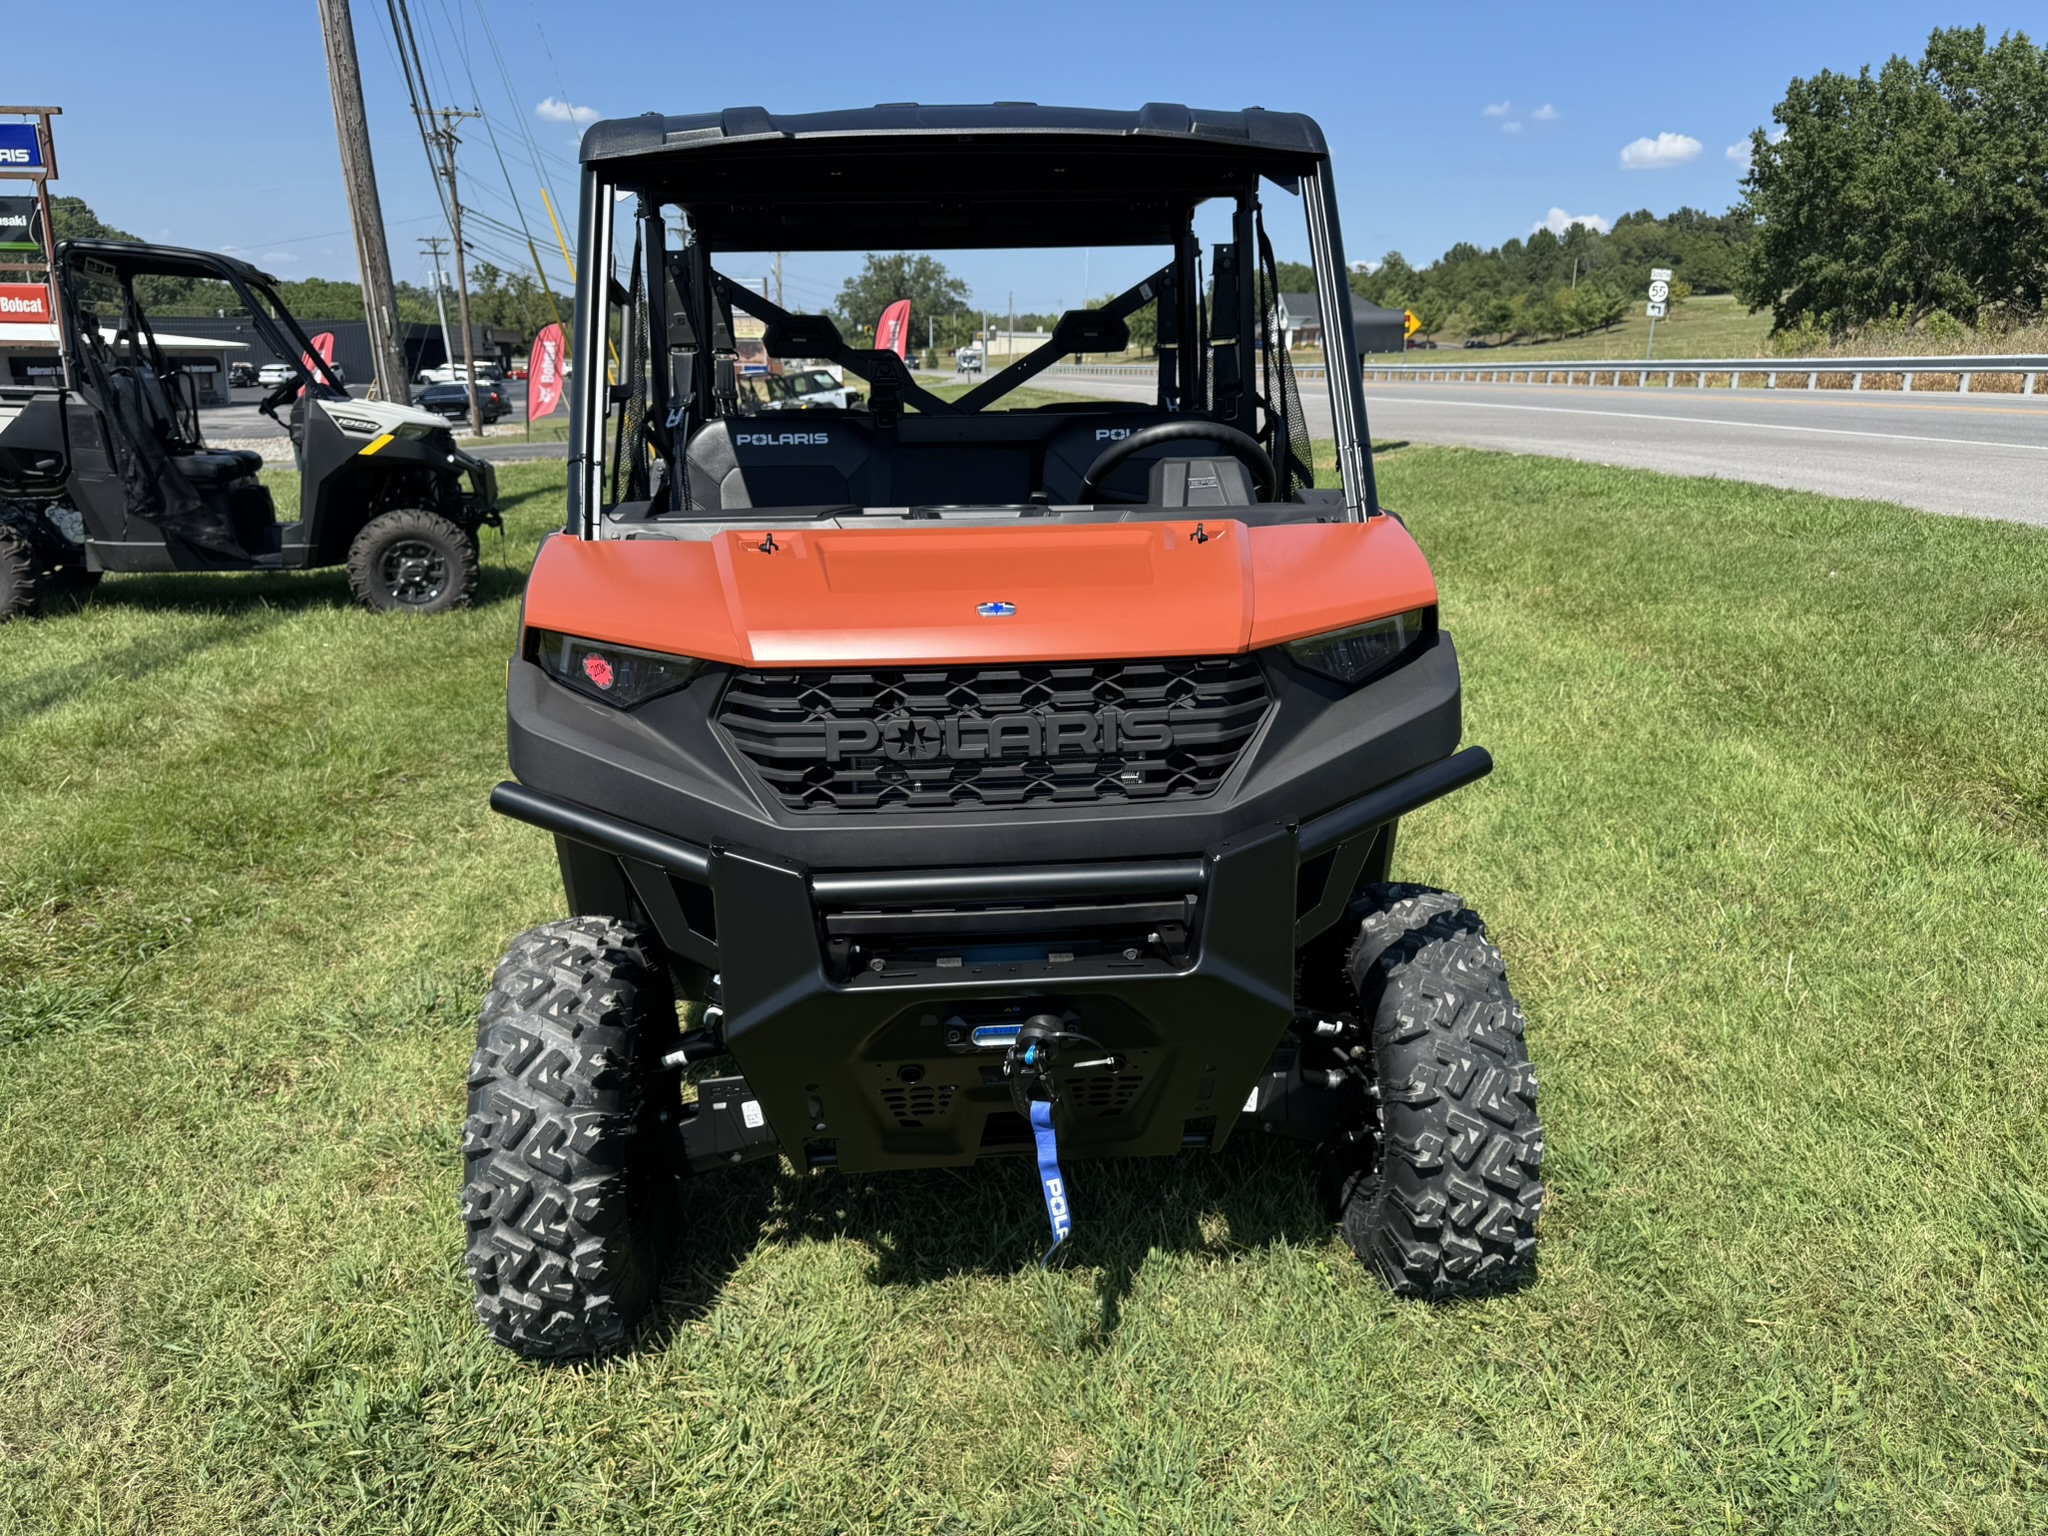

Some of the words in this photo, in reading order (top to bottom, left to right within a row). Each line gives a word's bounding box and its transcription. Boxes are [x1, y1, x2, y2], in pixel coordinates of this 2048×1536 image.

[1651, 285, 1666, 298] 55
[0, 297, 43, 313] Bobcat
[338, 418, 380, 430] 1000
[736, 433, 829, 446] POLARIS
[824, 709, 1174, 762] POLARIS
